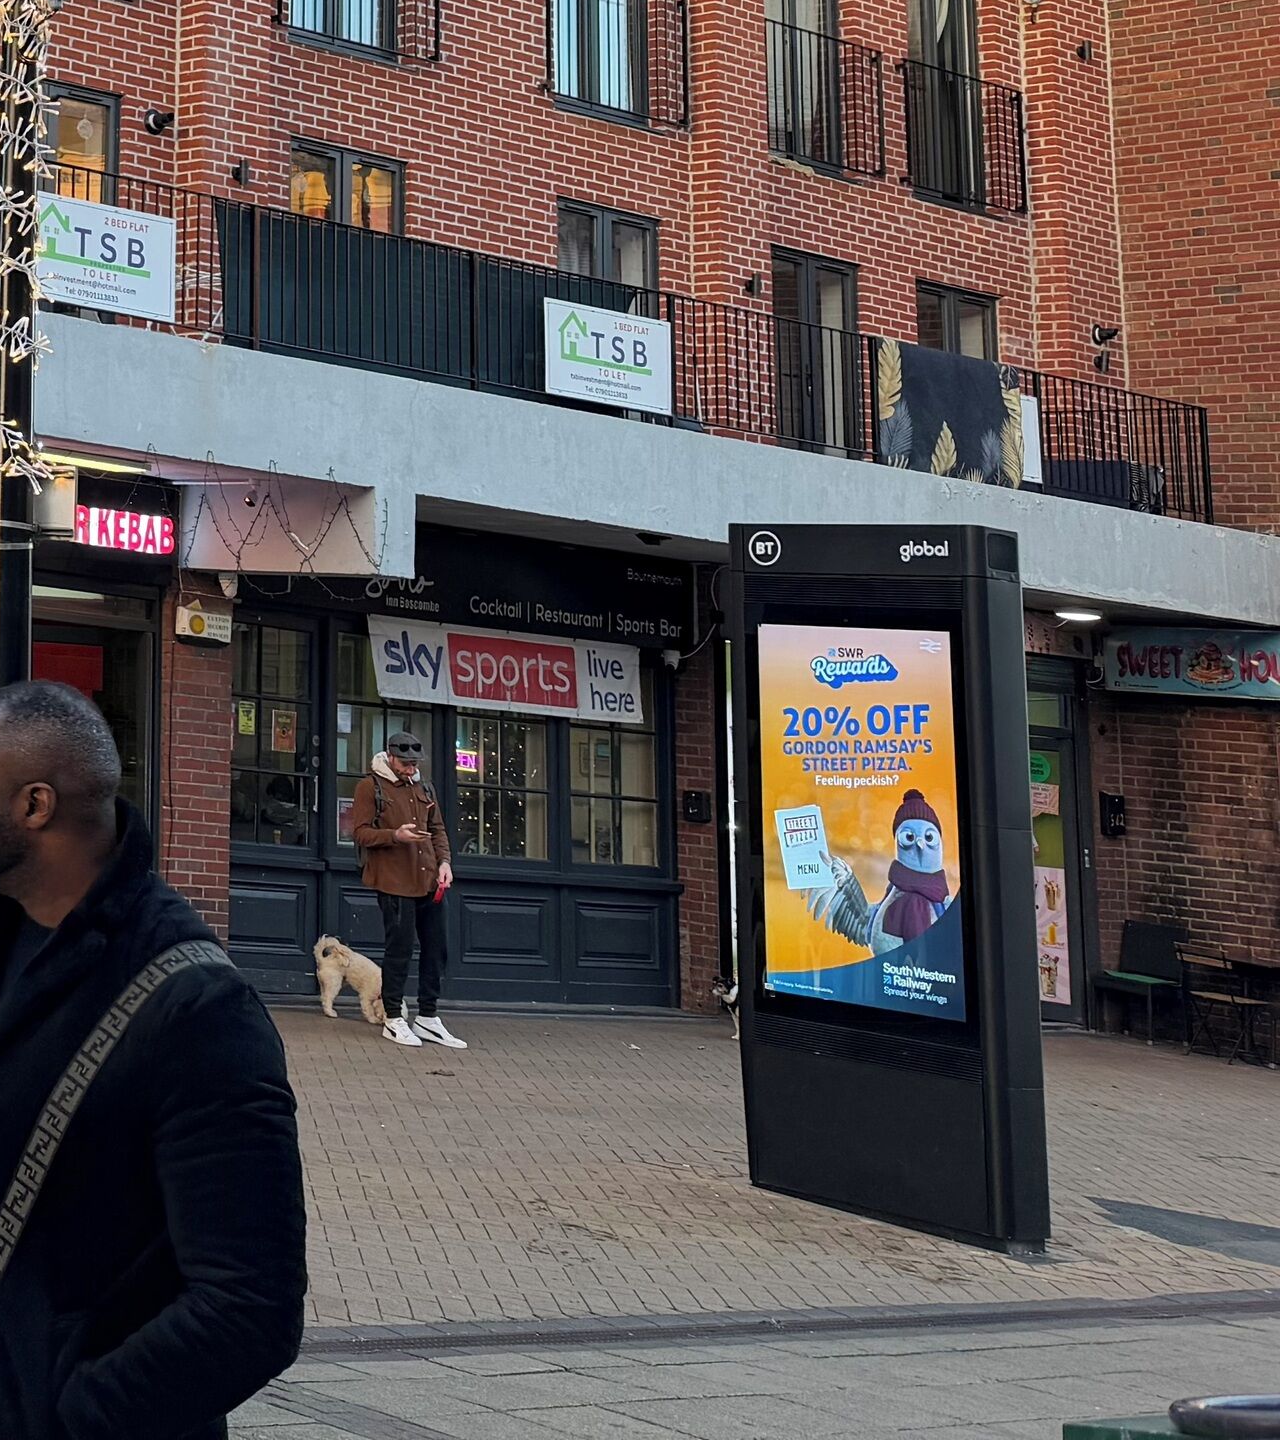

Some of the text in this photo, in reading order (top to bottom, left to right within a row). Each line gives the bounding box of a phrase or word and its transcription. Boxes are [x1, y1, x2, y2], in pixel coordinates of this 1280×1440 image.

[104, 217, 149, 233] 2 BED FLAT
[83, 268, 118, 282] TO LET
[619, 323, 633, 333] BED
[634, 326, 649, 336] FLAT
[599, 367, 609, 378] TO
[611, 370, 626, 381] LET
[98, 509, 175, 554] KEBAB
[755, 541, 774, 556] BT
[899, 540, 949, 563] global
[470, 596, 682, 638] Cocktail Restaurant Sports Bar
[384, 630, 572, 694] sky sports
[837, 647, 864, 659] SWR
[1116, 642, 1184, 680] SWEET
[587, 649, 625, 681] live
[811, 654, 891, 682] Rewards
[590, 683, 636, 713] here
[782, 703, 930, 737] 20% OFF
[782, 739, 933, 755] GORDON RAMSAY'S
[802, 757, 913, 772] STREET PIZZA.
[815, 774, 900, 788] Feeling peckish?
[797, 863, 820, 875] MENU
[882, 962, 956, 984] South Western
[893, 975, 933, 994] Railway
[883, 986, 948, 1005] Spread your wings
